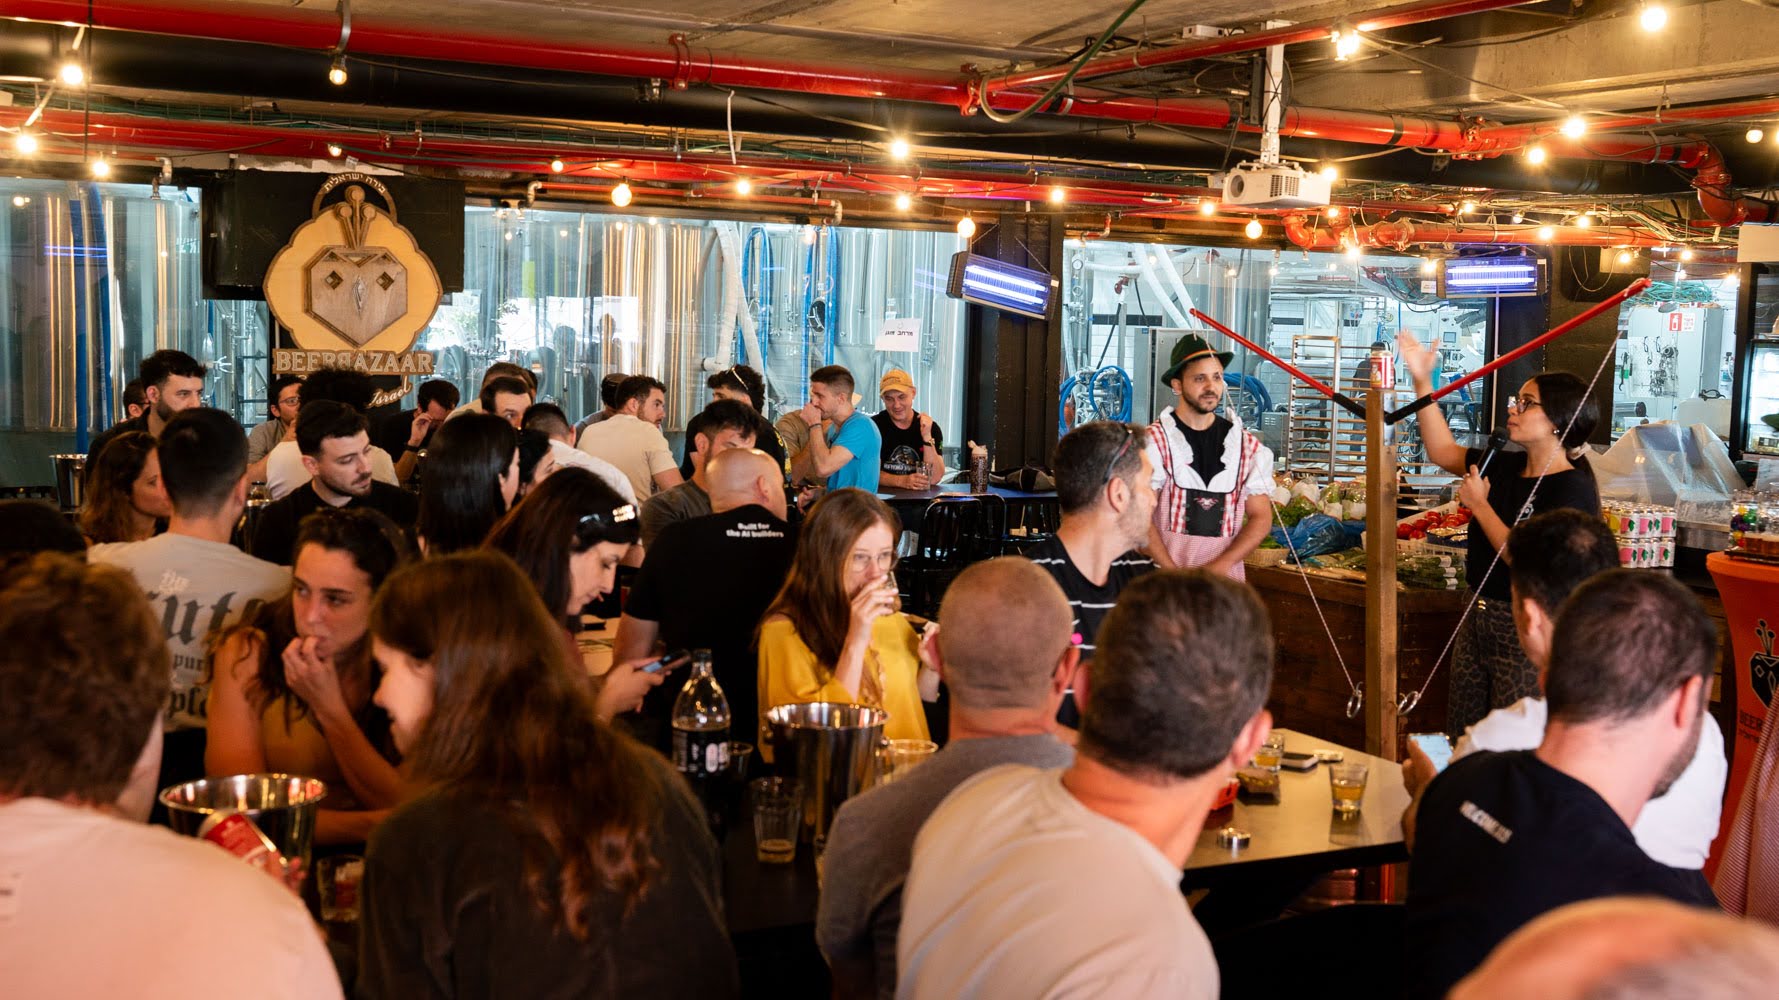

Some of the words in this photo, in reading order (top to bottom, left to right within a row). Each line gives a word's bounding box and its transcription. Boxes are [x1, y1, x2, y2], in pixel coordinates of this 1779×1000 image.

[324, 173, 363, 192] ישראלית
[366, 175, 386, 193] בירה
[368, 375, 412, 405] Israel
[726, 529, 740, 537] the
